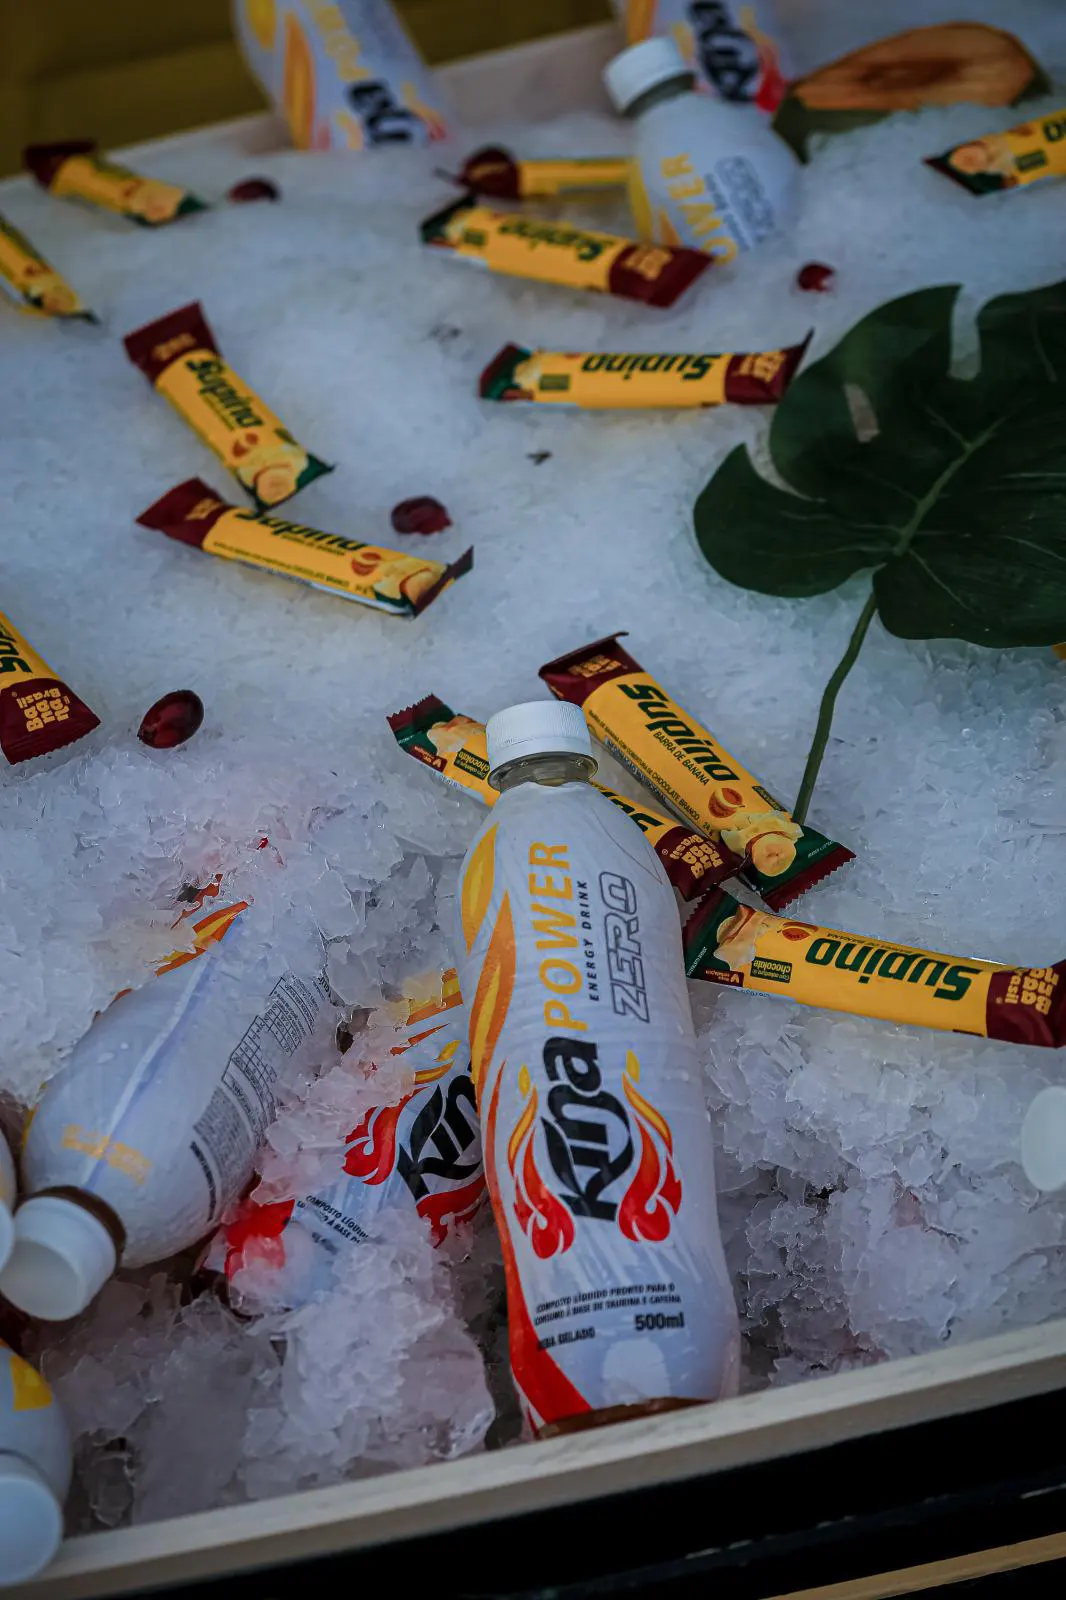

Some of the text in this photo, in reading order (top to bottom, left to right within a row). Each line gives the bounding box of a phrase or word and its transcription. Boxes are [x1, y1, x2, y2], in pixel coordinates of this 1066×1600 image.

[660, 152, 738, 267] OWER
[16, 687, 61, 709] Brasil
[616, 683, 740, 781] Supino
[652, 728, 677, 755] BARRA
[672, 749, 684, 762] DE
[681, 755, 710, 788] BANANA
[650, 769, 680, 802] CHOCOLATE
[527, 841, 589, 1032] POWER
[576, 880, 600, 1001] ENERGY DRINK
[598, 871, 651, 1024] ZERO
[752, 959, 790, 974] chocolate
[805, 937, 984, 1001] Supino
[397, 1074, 484, 1202] Kin
[540, 1036, 635, 1222] Kina
[304, 1190, 342, 1222] COMPOSTO
[333, 1222, 351, 1238] BASE
[537, 1296, 572, 1312] COMPOSTO
[609, 1285, 644, 1296] PRONTO
[646, 1283, 666, 1292] PARA
[634, 1312, 685, 1331] 500ml
